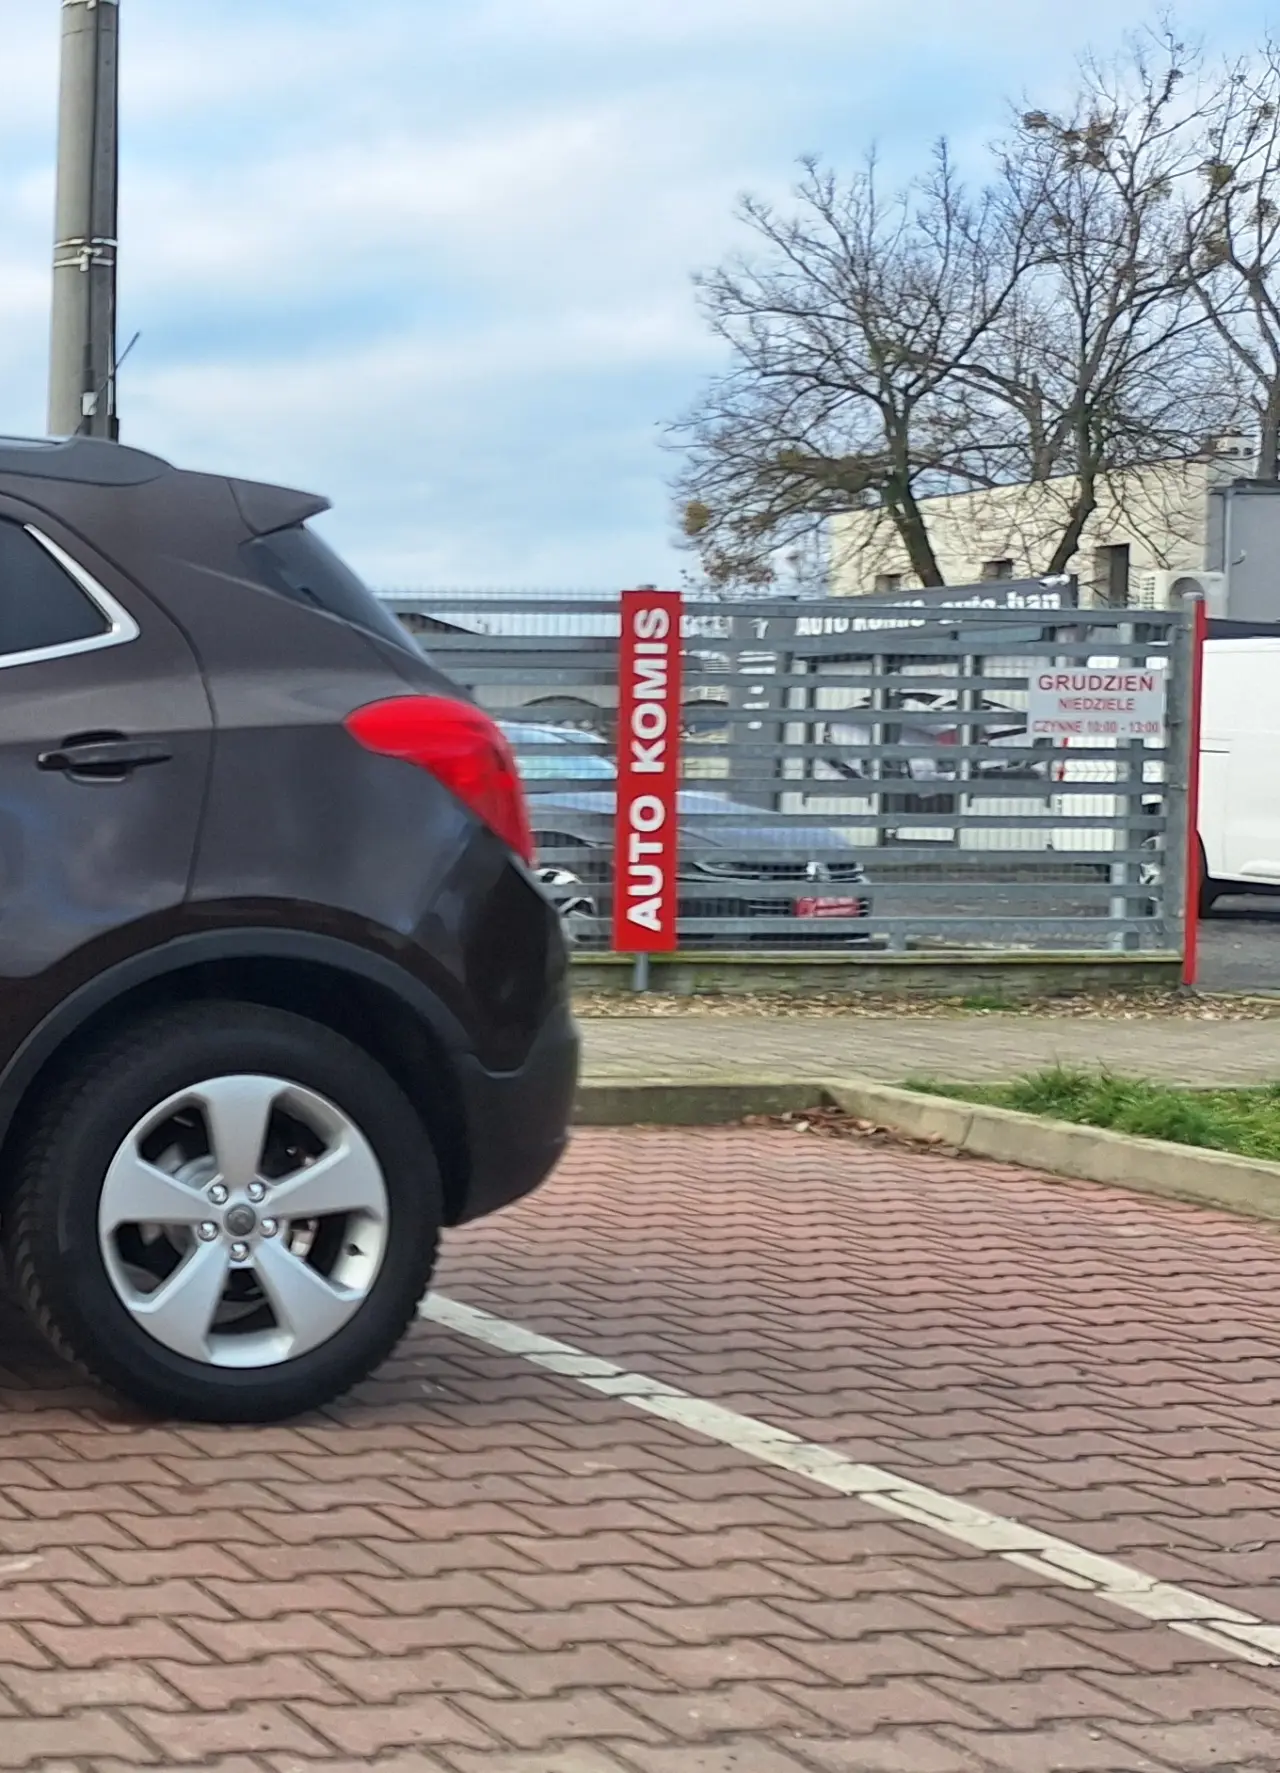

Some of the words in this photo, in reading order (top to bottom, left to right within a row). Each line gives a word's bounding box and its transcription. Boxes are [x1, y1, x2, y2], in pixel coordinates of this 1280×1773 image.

[630, 607, 670, 773] KOMIS
[1038, 672, 1154, 692] GRUDZIEŃ
[1058, 698, 1136, 711] NIEDZIELE
[626, 794, 666, 932] AUTO
